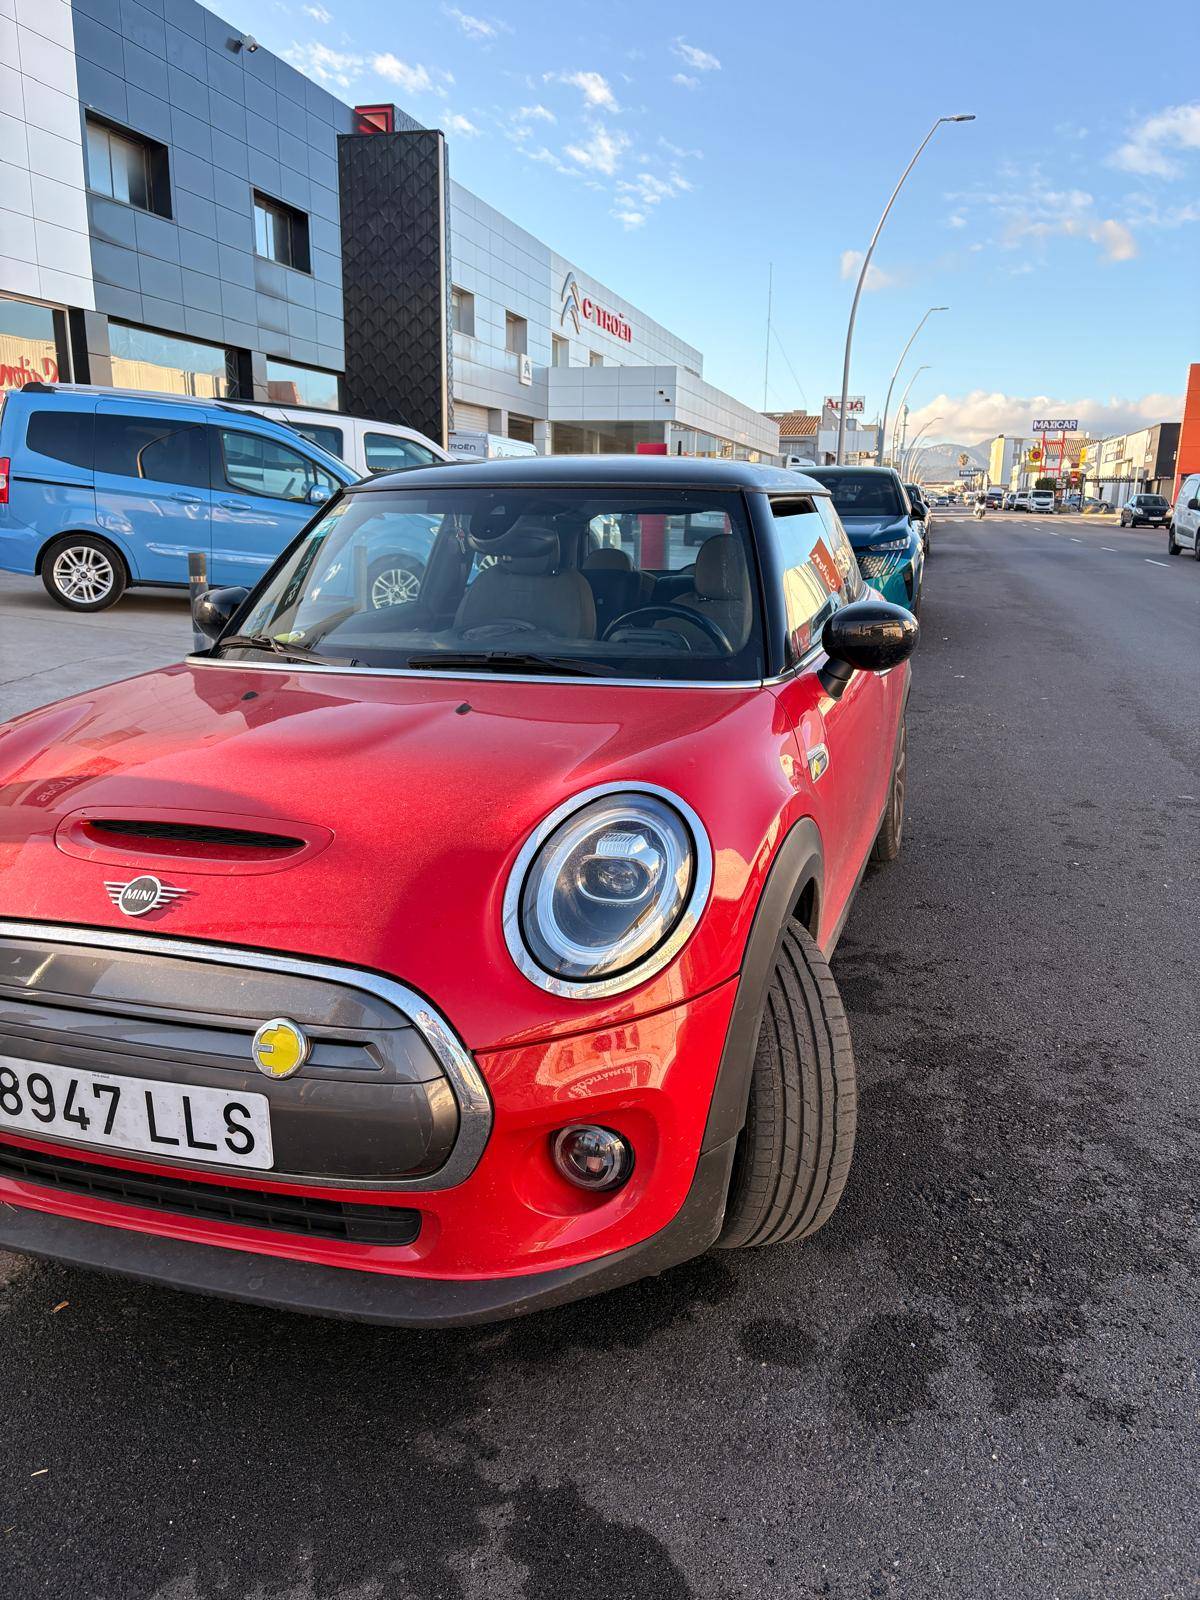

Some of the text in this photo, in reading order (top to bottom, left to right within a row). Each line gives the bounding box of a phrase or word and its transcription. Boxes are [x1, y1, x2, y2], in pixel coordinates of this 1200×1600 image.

[582, 298, 632, 343] CITROËN
[1033, 420, 1077, 429] MAXICAR
[448, 443, 477, 451] TROËN
[125, 888, 155, 902] MINI
[0, 1066, 255, 1155] 8947 LLS
